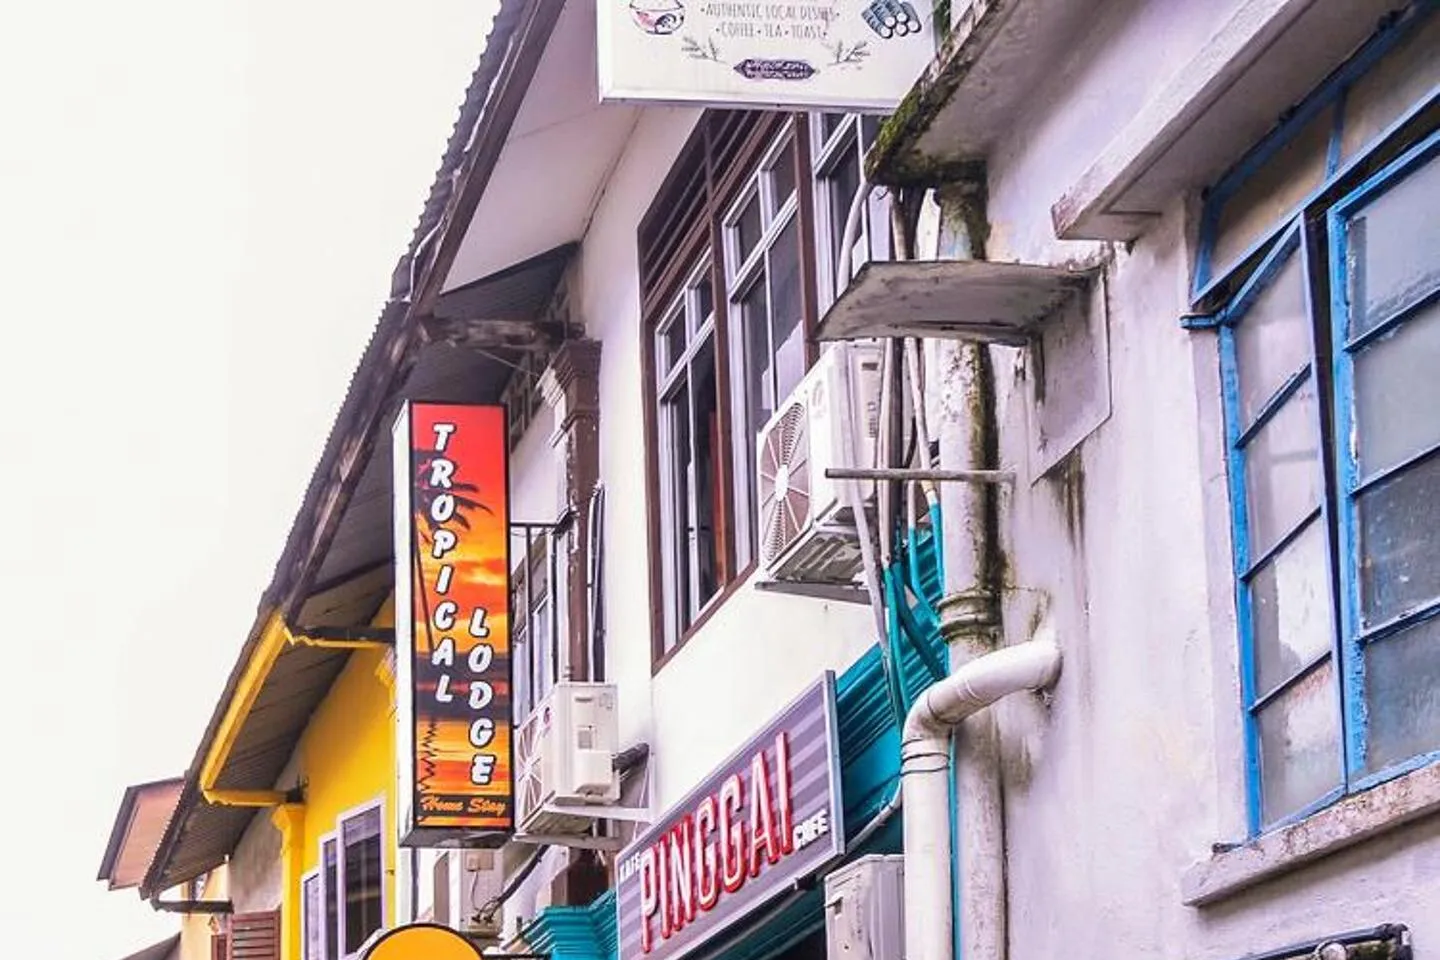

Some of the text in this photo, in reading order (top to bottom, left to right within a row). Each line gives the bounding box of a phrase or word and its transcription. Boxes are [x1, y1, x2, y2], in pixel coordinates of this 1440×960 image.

[428, 422, 457, 704] TROPICAL
[467, 606, 497, 786] LODGE
[468, 797, 506, 817] Stay
[638, 730, 795, 955] PINGGAI
